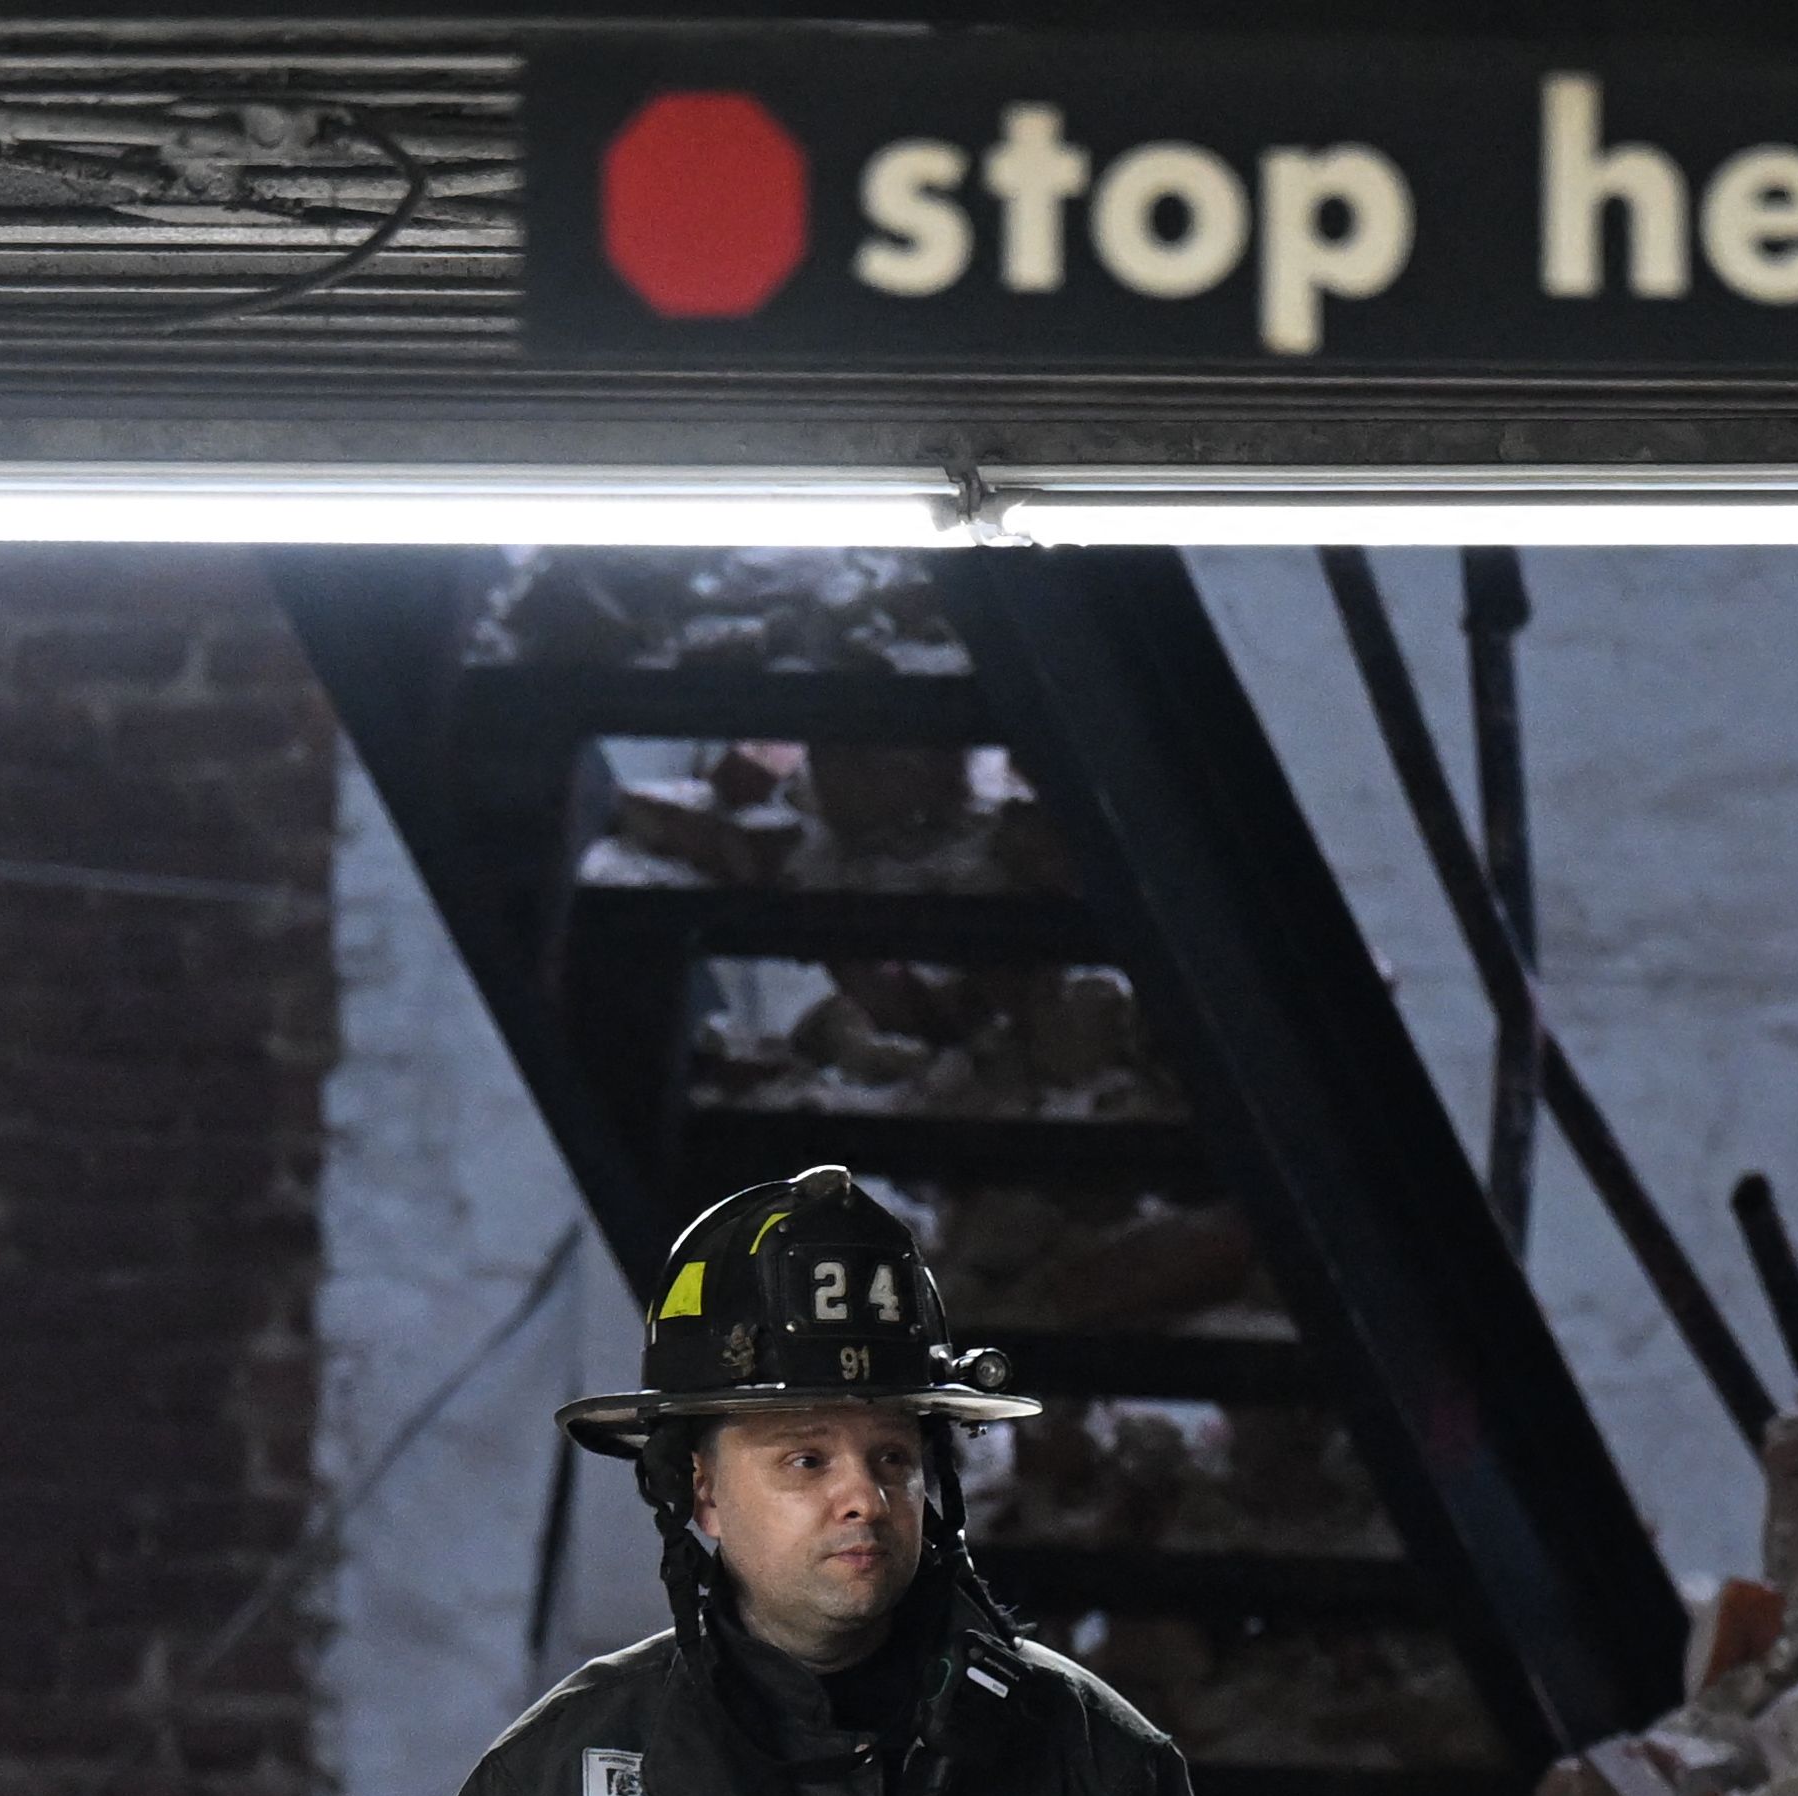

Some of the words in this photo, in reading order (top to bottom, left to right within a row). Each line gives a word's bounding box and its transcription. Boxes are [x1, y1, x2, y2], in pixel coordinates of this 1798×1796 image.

[853, 102, 1416, 355] stop
[813, 1261, 901, 1322] 24
[840, 1345, 871, 1381] 91
